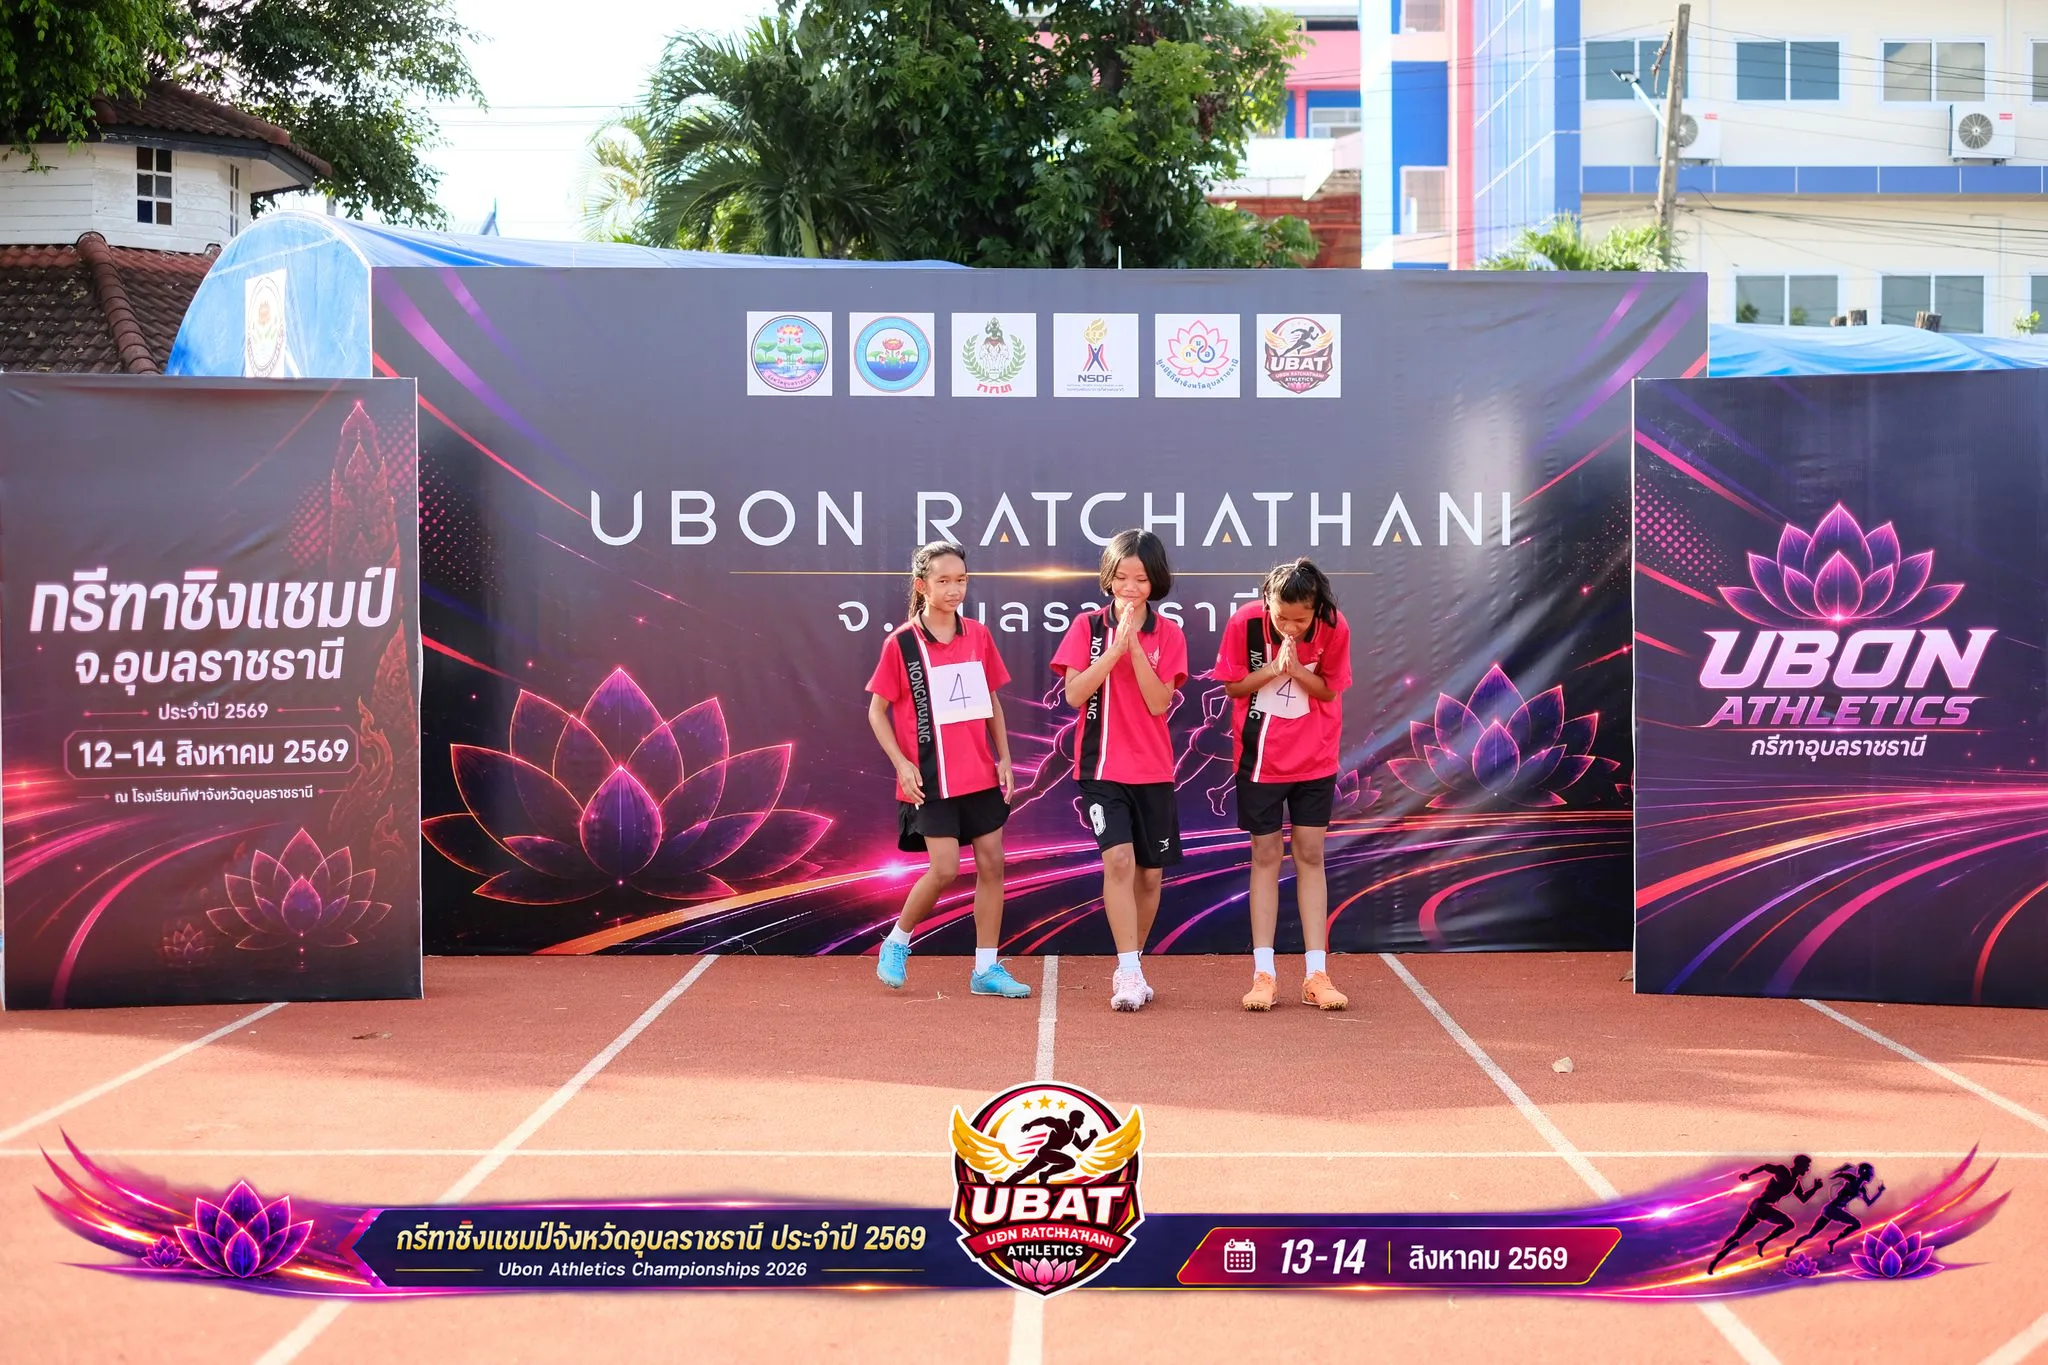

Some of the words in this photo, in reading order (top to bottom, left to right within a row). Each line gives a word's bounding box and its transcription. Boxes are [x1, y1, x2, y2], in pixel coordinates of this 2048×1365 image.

[1078, 374, 1113, 383] NSDF
[1270, 356, 1328, 371] UBAT
[590, 490, 864, 547] UBON
[917, 490, 1511, 547] RATCHATHANI
[29, 566, 397, 632] กรีฑาชิงแชมป์
[75, 636, 345, 696] จ.อุบลราชธานี
[1699, 628, 2000, 690] UBON
[907, 660, 931, 744] NONGMUANG
[949, 672, 972, 709] 4
[1276, 677, 1297, 708] 4
[158, 702, 220, 721] ประจำปี
[224, 702, 269, 720] 2569
[1692, 696, 1990, 728] ATHLETICS
[175, 739, 274, 767] สิงหาคม
[283, 738, 349, 764] 2569
[1750, 733, 1928, 762] กรีฑาอุบลราชธานี
[114, 792, 129, 803] ณ
[131, 784, 314, 804] โรงเรียนกีฬาจังหวัดอุบลราชธานี
